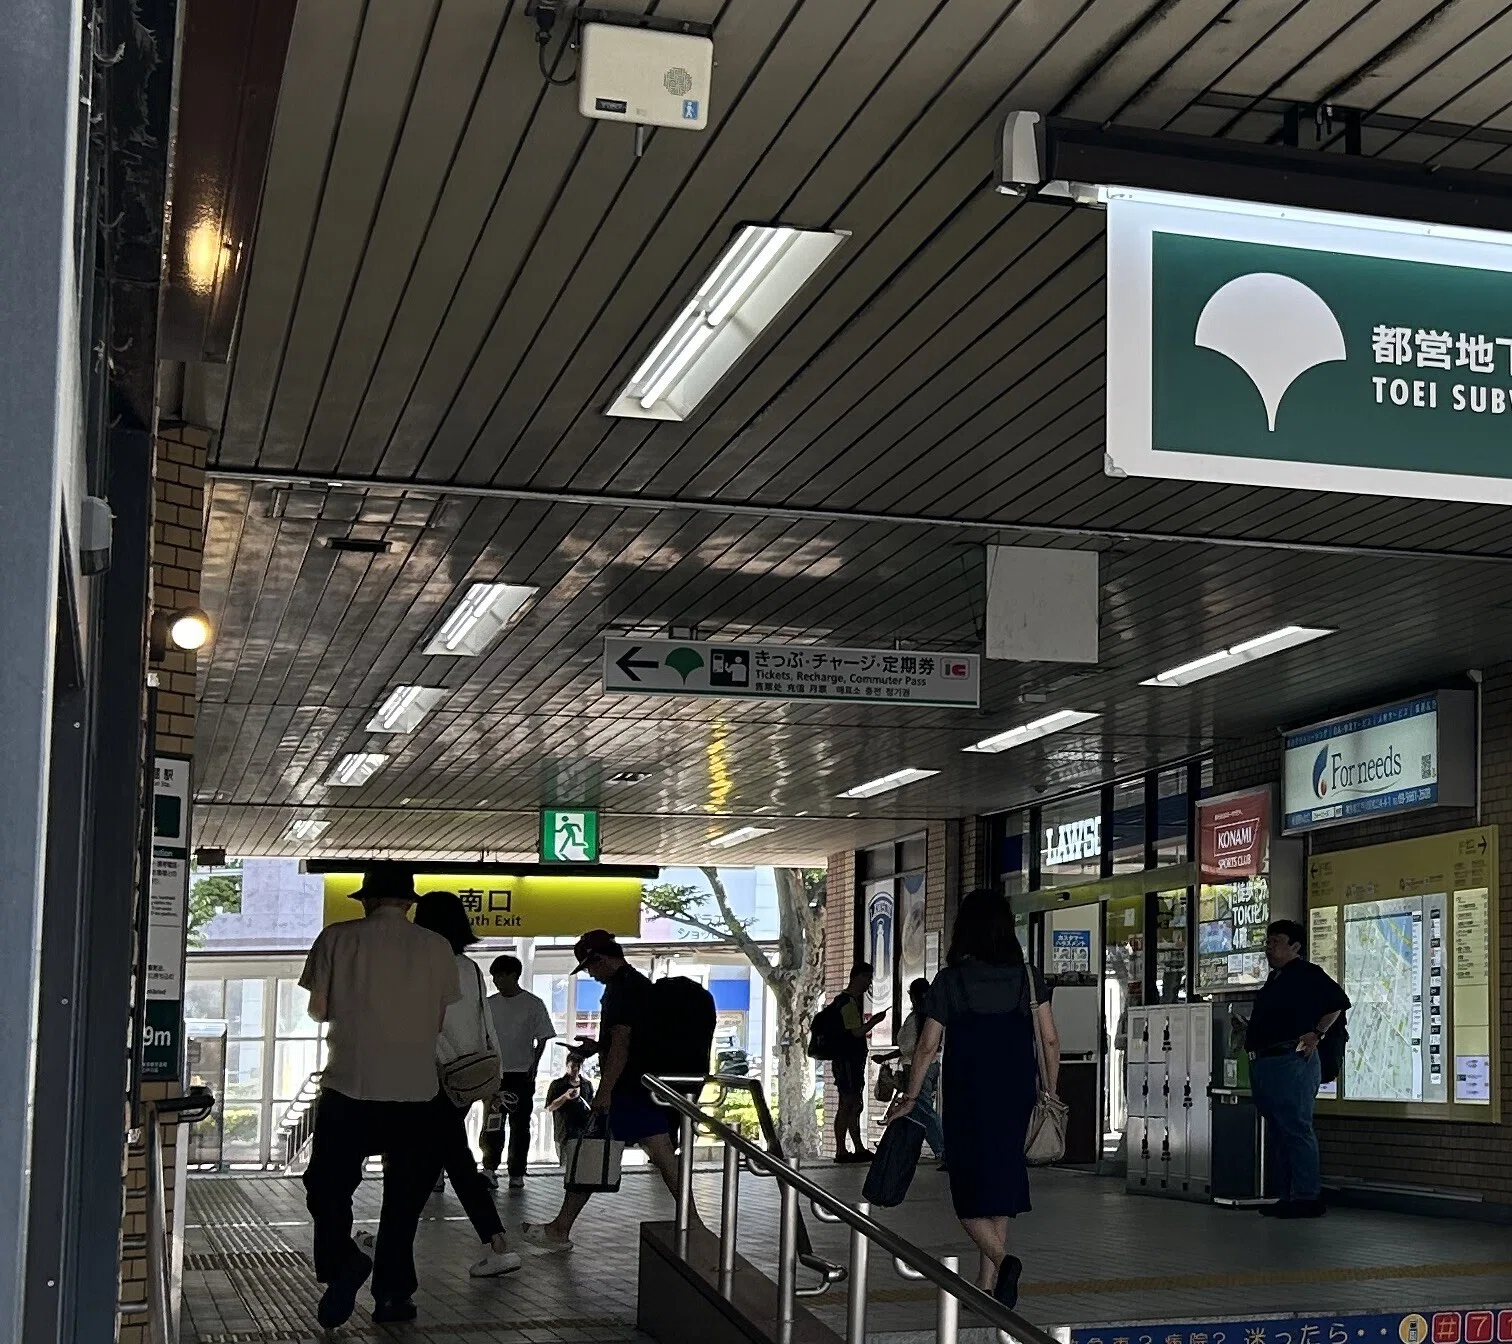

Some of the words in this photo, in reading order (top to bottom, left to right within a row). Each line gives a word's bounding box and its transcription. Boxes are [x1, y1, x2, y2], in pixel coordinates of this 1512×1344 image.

[1371, 376, 1437, 408] TOEI
[755, 669, 794, 681] Tickets,
[796, 671, 846, 684] Recharge,
[850, 674, 903, 686] Commuter
[905, 677, 927, 687] Pass
[1217, 825, 1252, 850] KONAMI
[1217, 856, 1237, 870] SPORTS
[1237, 854, 1252, 868] CLUB
[458, 888, 512, 913] 南口
[496, 914, 522, 927] Exit
